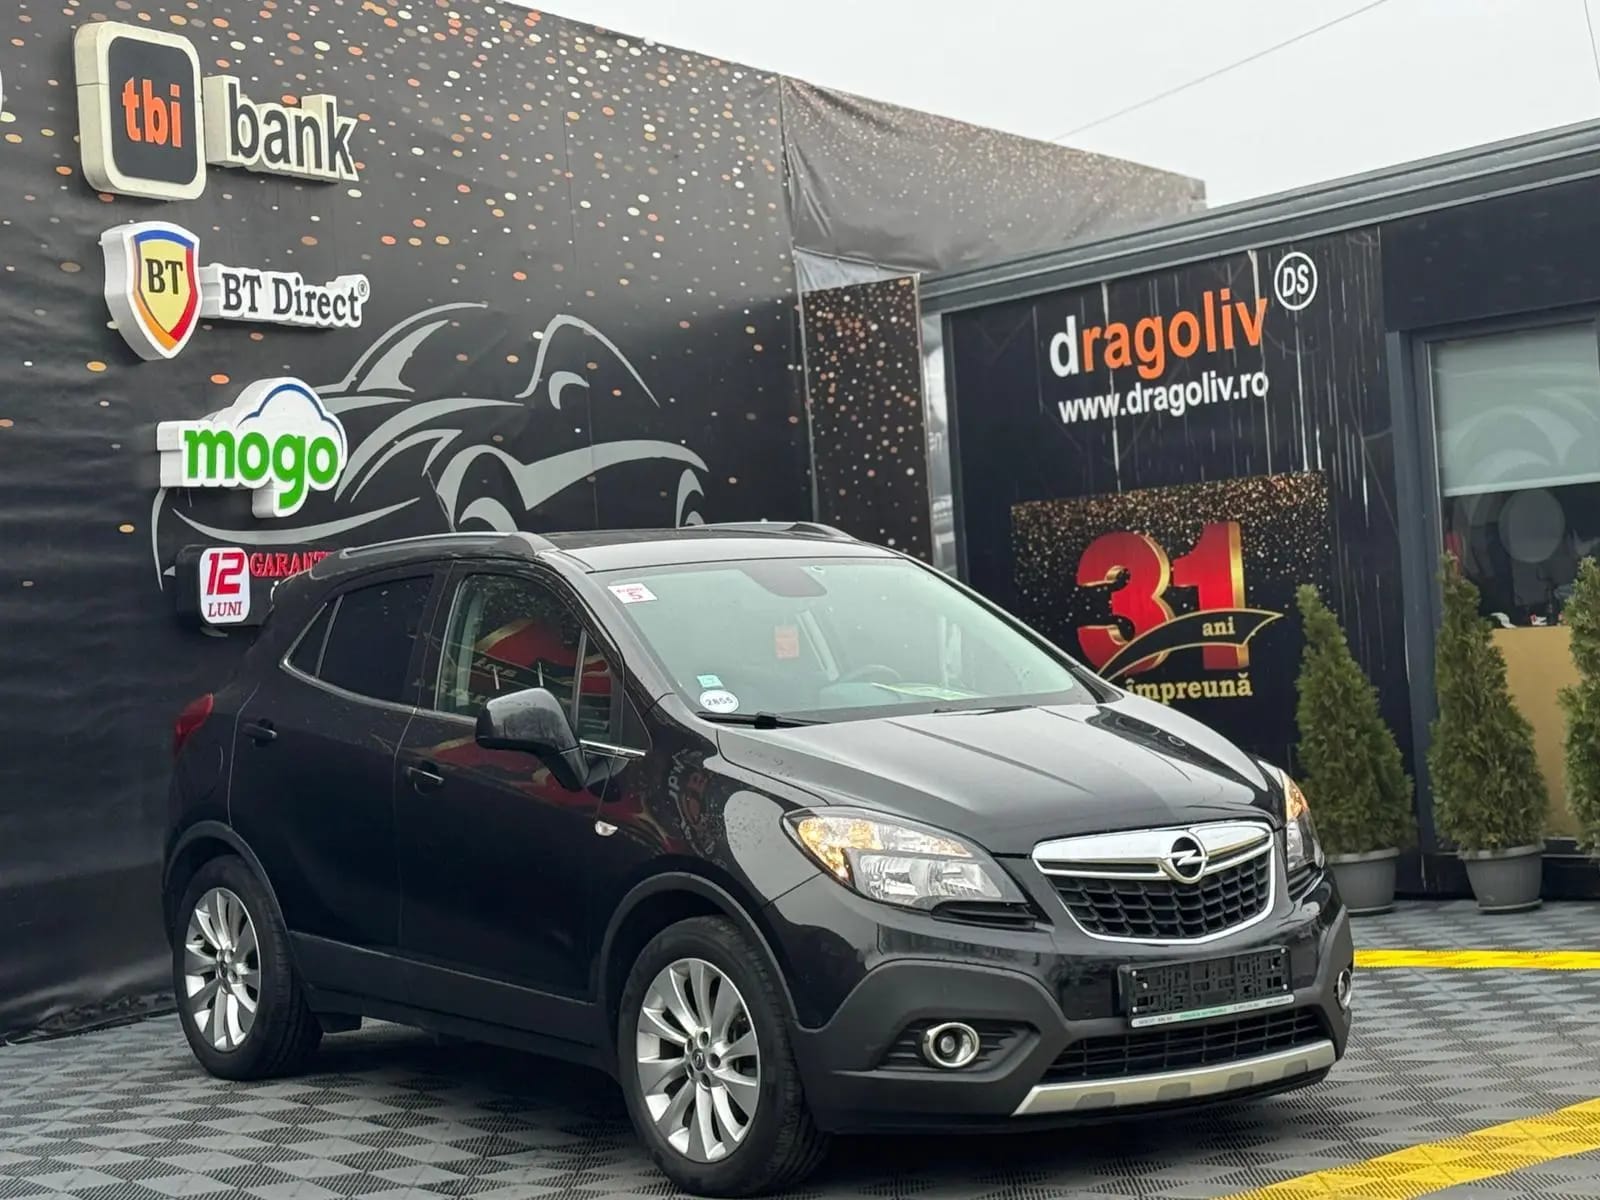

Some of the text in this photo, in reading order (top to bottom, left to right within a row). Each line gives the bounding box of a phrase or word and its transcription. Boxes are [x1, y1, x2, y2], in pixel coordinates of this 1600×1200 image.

[122, 77, 355, 175] tbi bank
[145, 258, 183, 295] BT
[222, 272, 262, 313] BT
[1282, 263, 1310, 298] DS
[1049, 287, 1268, 380] dragoliv
[1058, 370, 1269, 425] www.dragoliv.ro
[184, 428, 339, 510] mogo
[207, 552, 245, 595] 12
[250, 551, 334, 577] GARANT
[208, 600, 242, 617] LUNI
[1075, 520, 1250, 677] 31
[1202, 616, 1235, 637] ani
